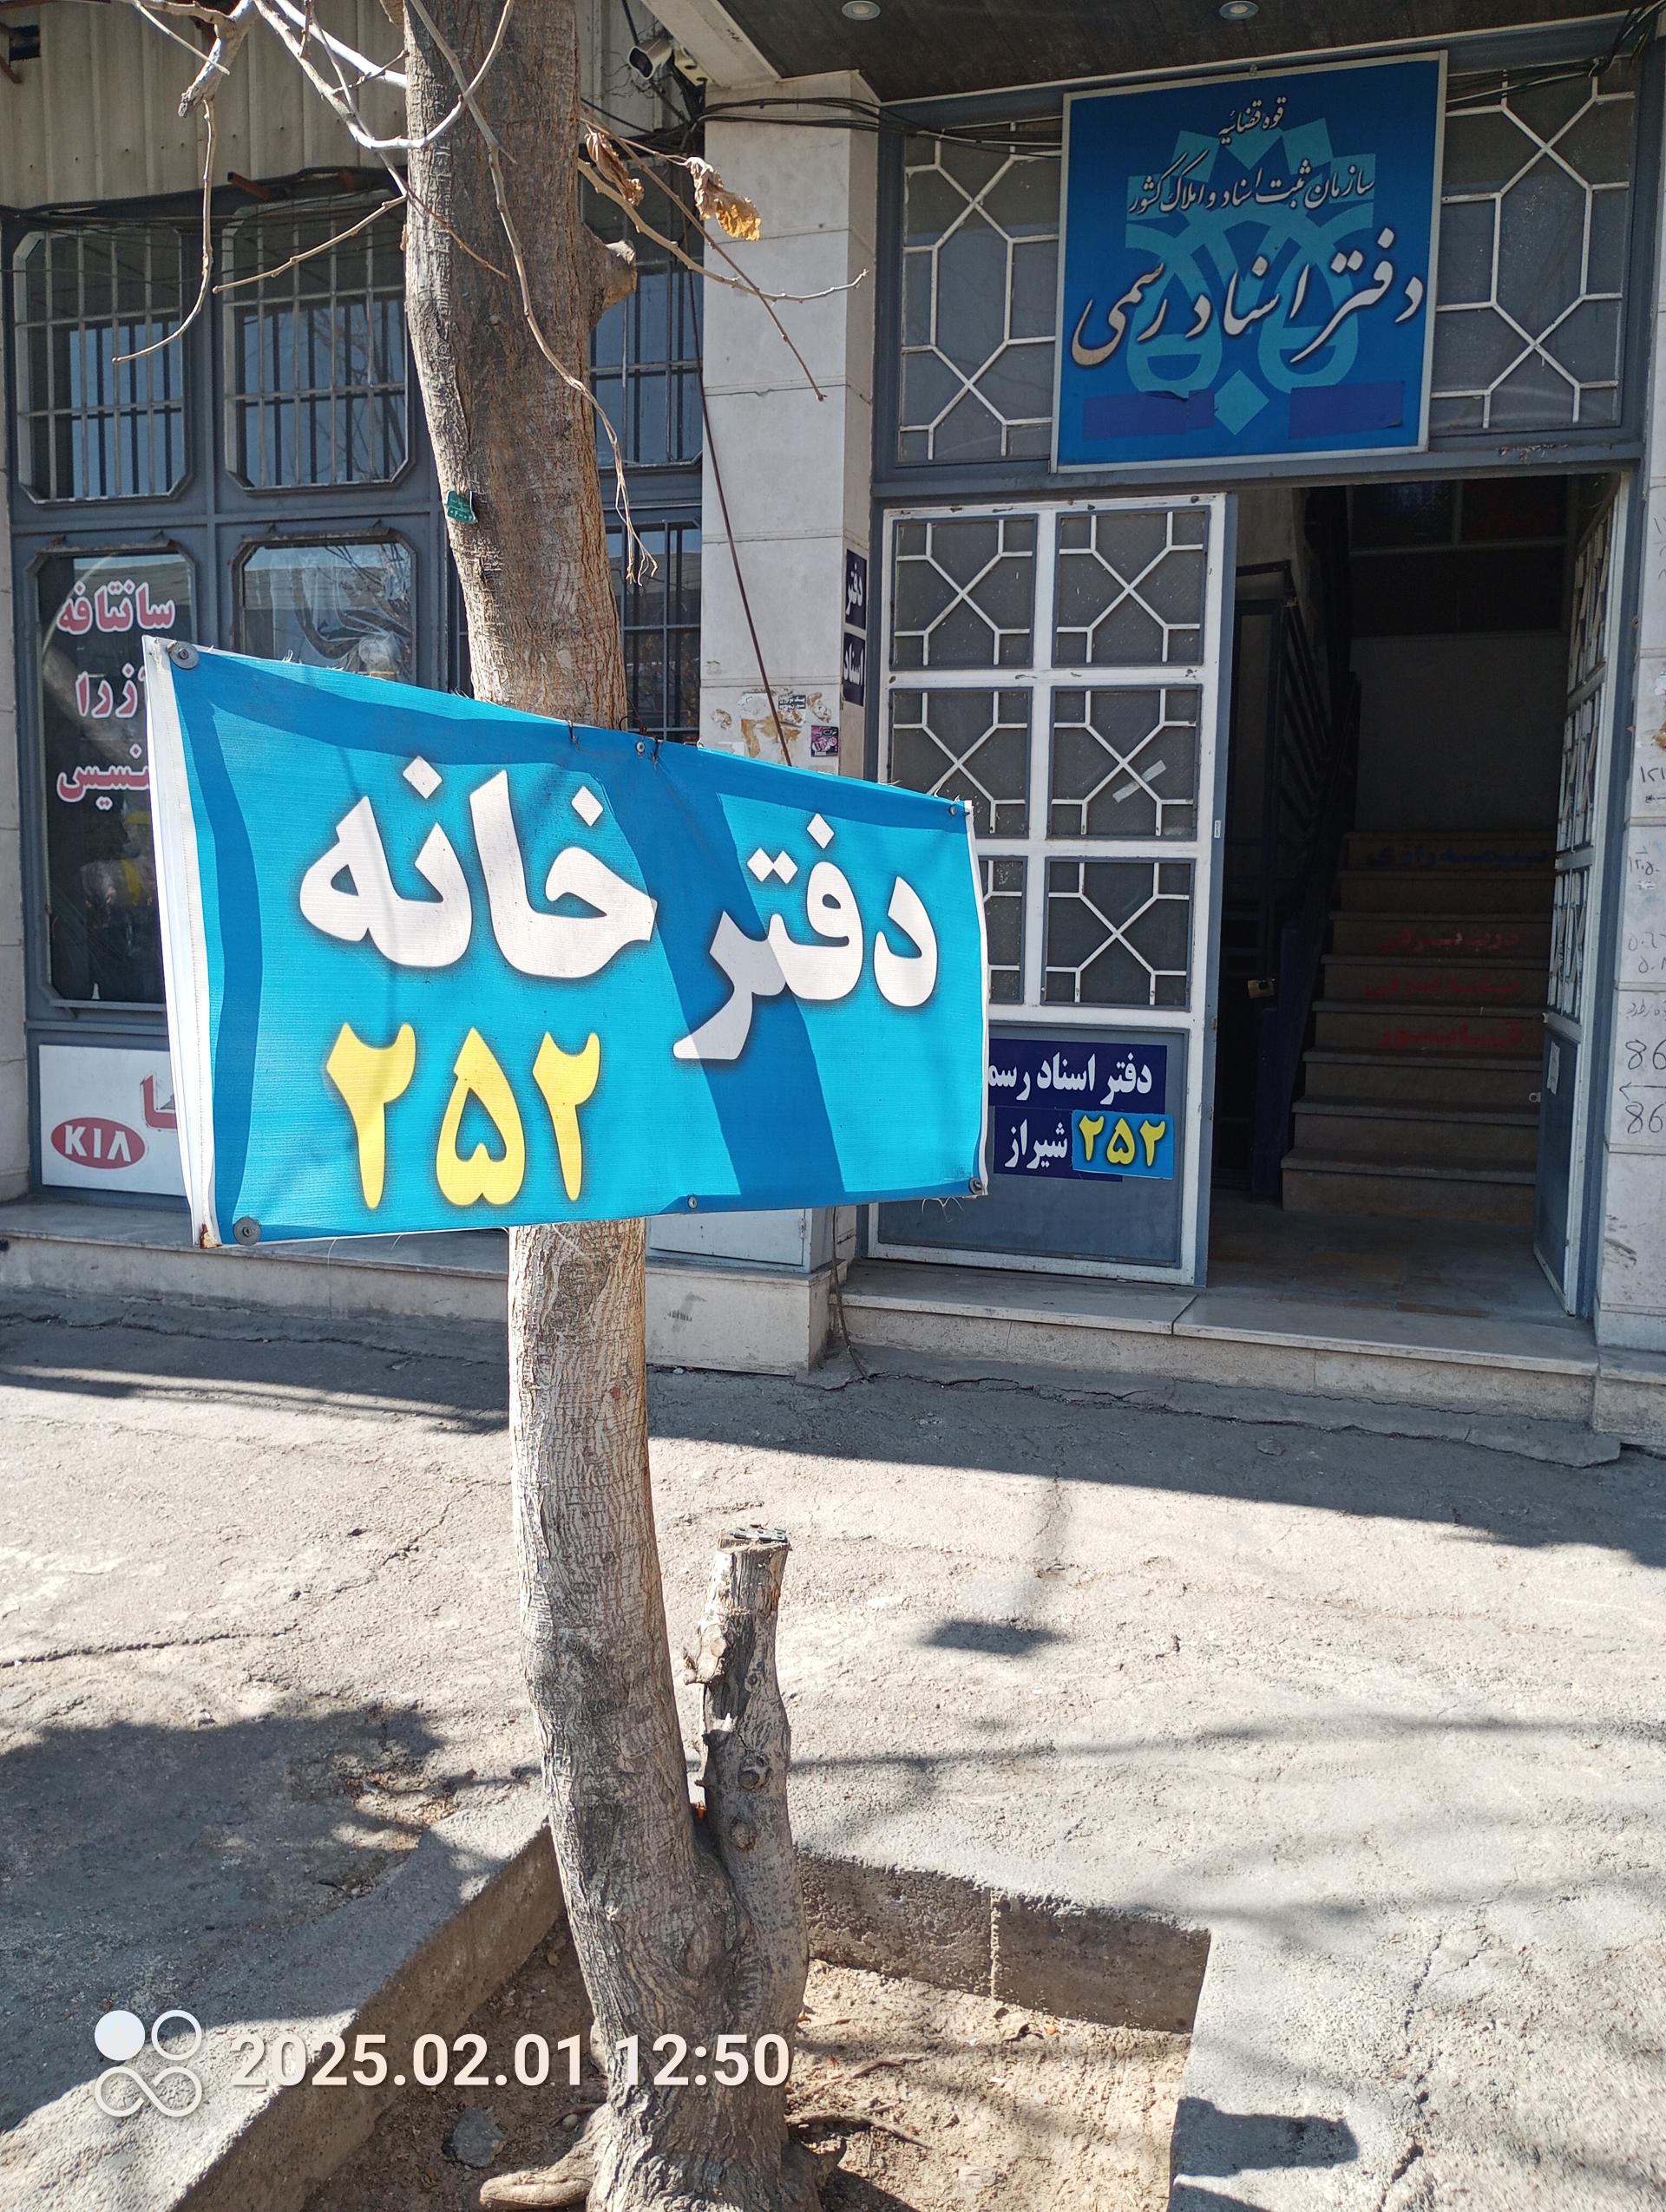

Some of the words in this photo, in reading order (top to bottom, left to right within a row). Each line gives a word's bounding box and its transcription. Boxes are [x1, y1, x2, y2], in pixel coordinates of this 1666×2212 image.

[1262, 96, 1288, 130] قوه
[1128, 152, 1188, 214] کشور
[1159, 148, 1209, 212] املاک
[1206, 192, 1217, 209] و
[1220, 167, 1263, 207] اسناد
[1256, 159, 1311, 208] ثبت
[1304, 165, 1374, 209] سازمان
[1071, 262, 1168, 367] رسمی
[1185, 255, 1310, 339] اسناد
[1289, 227, 1425, 363] دفتر
[56, 578, 176, 636] سانتافه
[845, 562, 863, 616] دفتر
[75, 663, 147, 718] زرا
[843, 642, 864, 686] اسناد
[56, 743, 150, 810] نسیس
[988, 1064, 1031, 1101] رسم
[1037, 1051, 1096, 1091] اسناد
[1099, 1052, 1152, 1105] دفتر
[325, 1022, 600, 1209] ۲۵۲
[1005, 1118, 1067, 1169] شیراز
[1079, 1114, 1166, 1167] ۲۵۲
[63, 1124, 132, 1162] KIA
